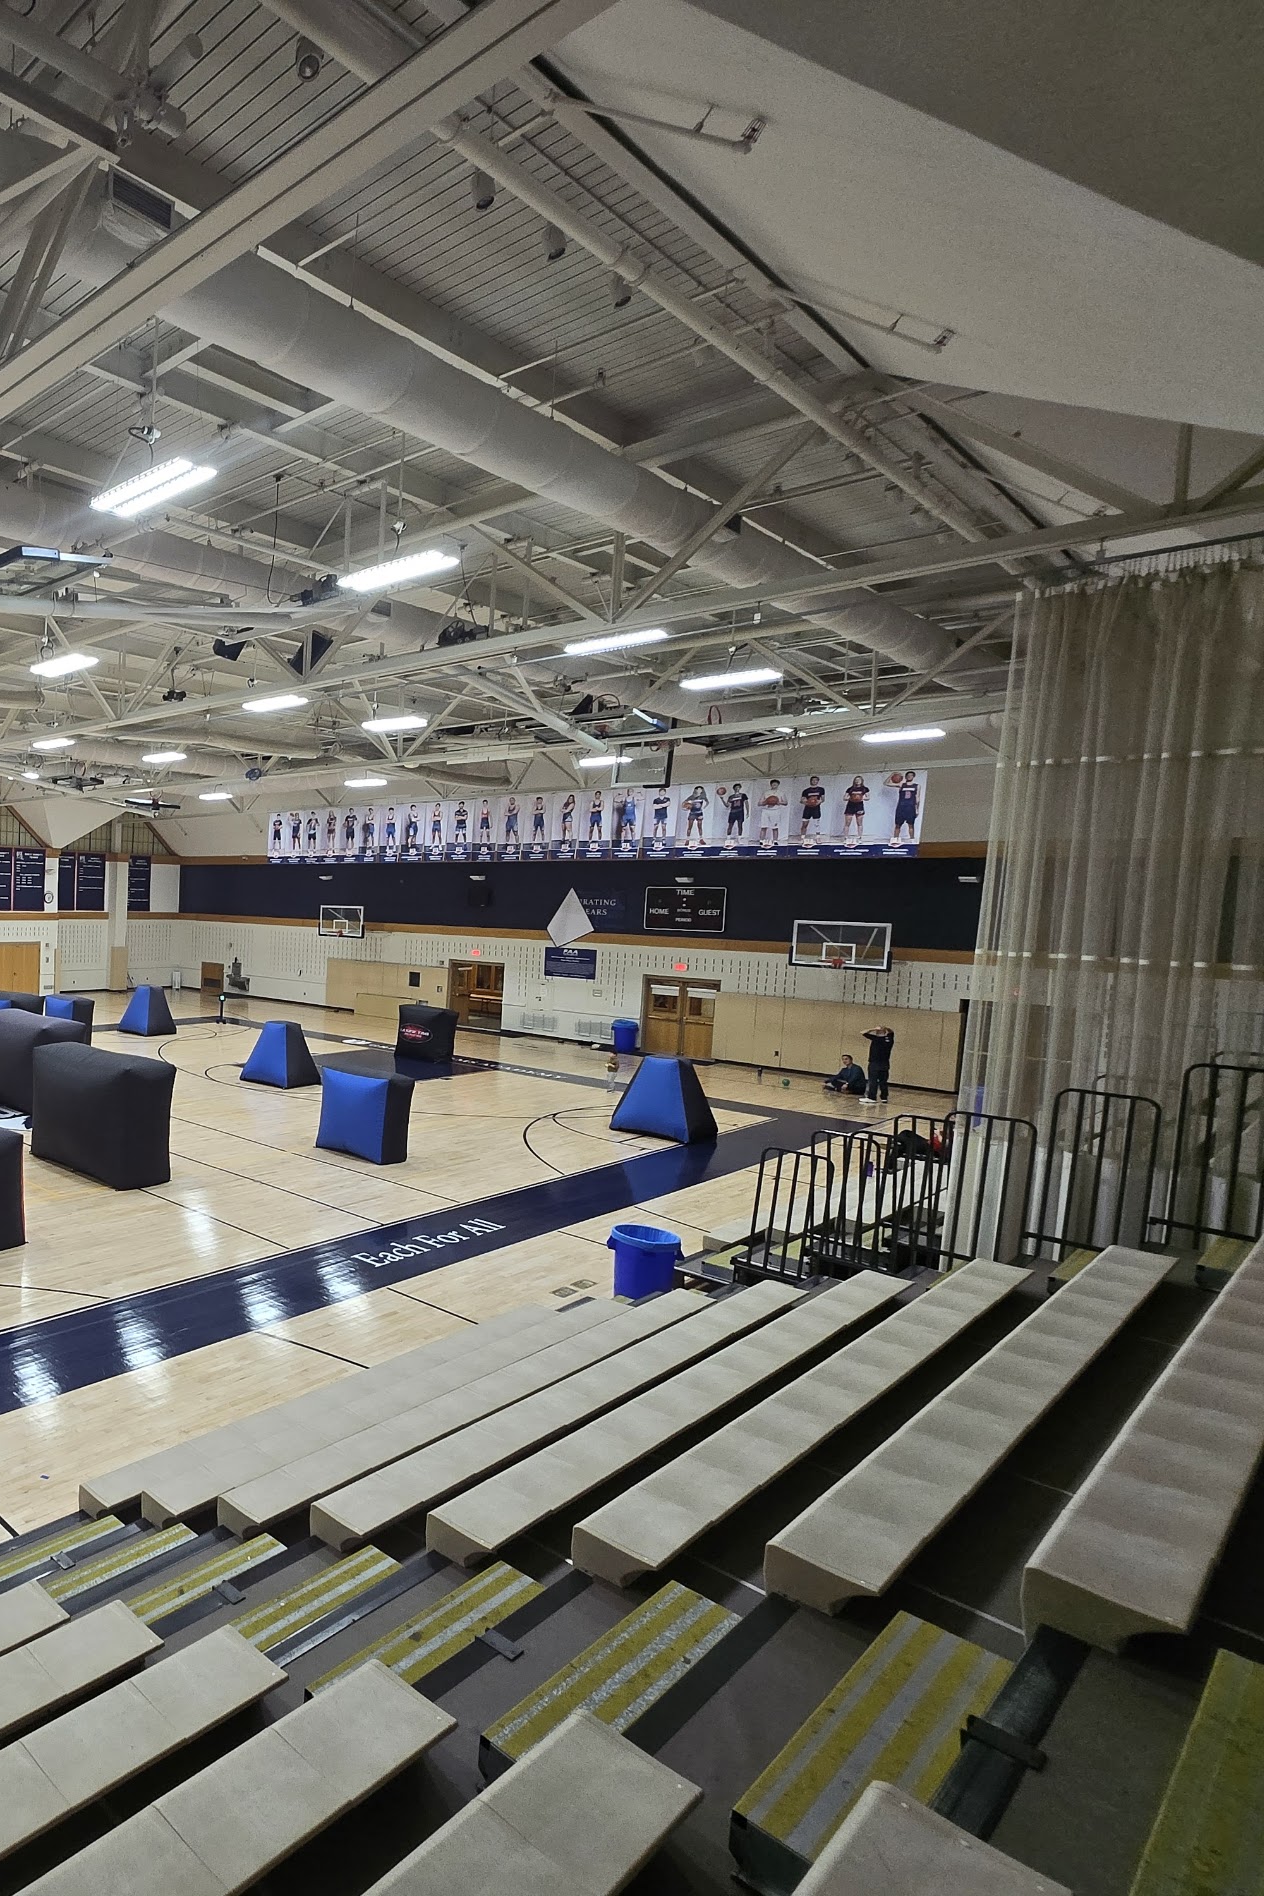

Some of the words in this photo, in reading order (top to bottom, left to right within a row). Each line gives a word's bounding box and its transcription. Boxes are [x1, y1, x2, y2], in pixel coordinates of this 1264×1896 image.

[580, 898, 616, 906] RATING
[585, 908, 608, 916] EARS
[649, 907, 670, 915] HOME
[350, 1242, 431, 1268] Each
[412, 1230, 470, 1249] For
[459, 1218, 507, 1237] All
